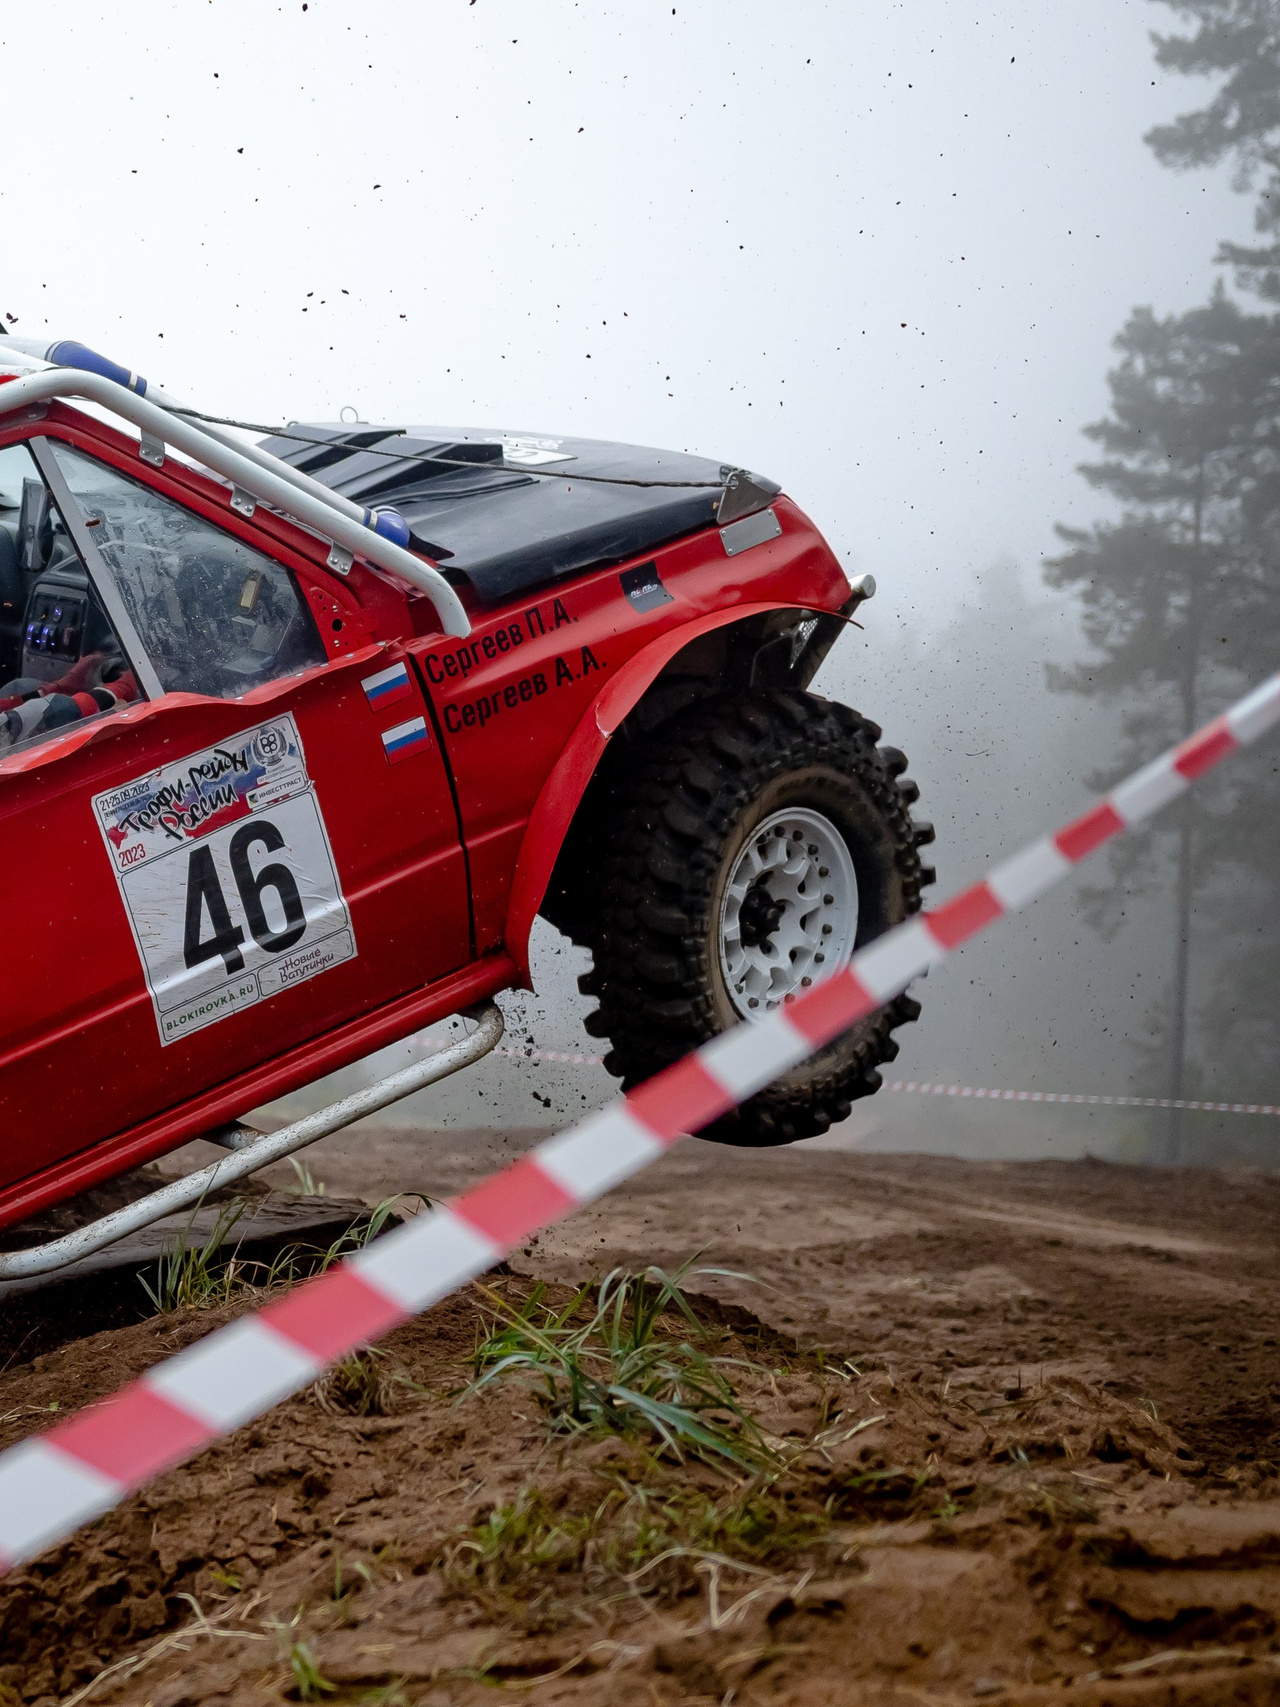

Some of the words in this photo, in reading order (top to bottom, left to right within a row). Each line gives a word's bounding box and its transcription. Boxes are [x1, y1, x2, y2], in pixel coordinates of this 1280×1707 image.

[424, 623, 523, 684] Сергеев
[443, 673, 548, 734] Сергеев
[554, 645, 607, 687] А.А.
[100, 781, 150, 811] 21-25.09.2023
[258, 777, 302, 798] ИНВЕСТТРАСТ
[118, 843, 146, 867] 2023
[183, 820, 307, 976] 46
[279, 953, 335, 984] Ватутинки
[280, 948, 321, 971] Новые
[166, 984, 254, 1031] BLOKIROVKA.RU
